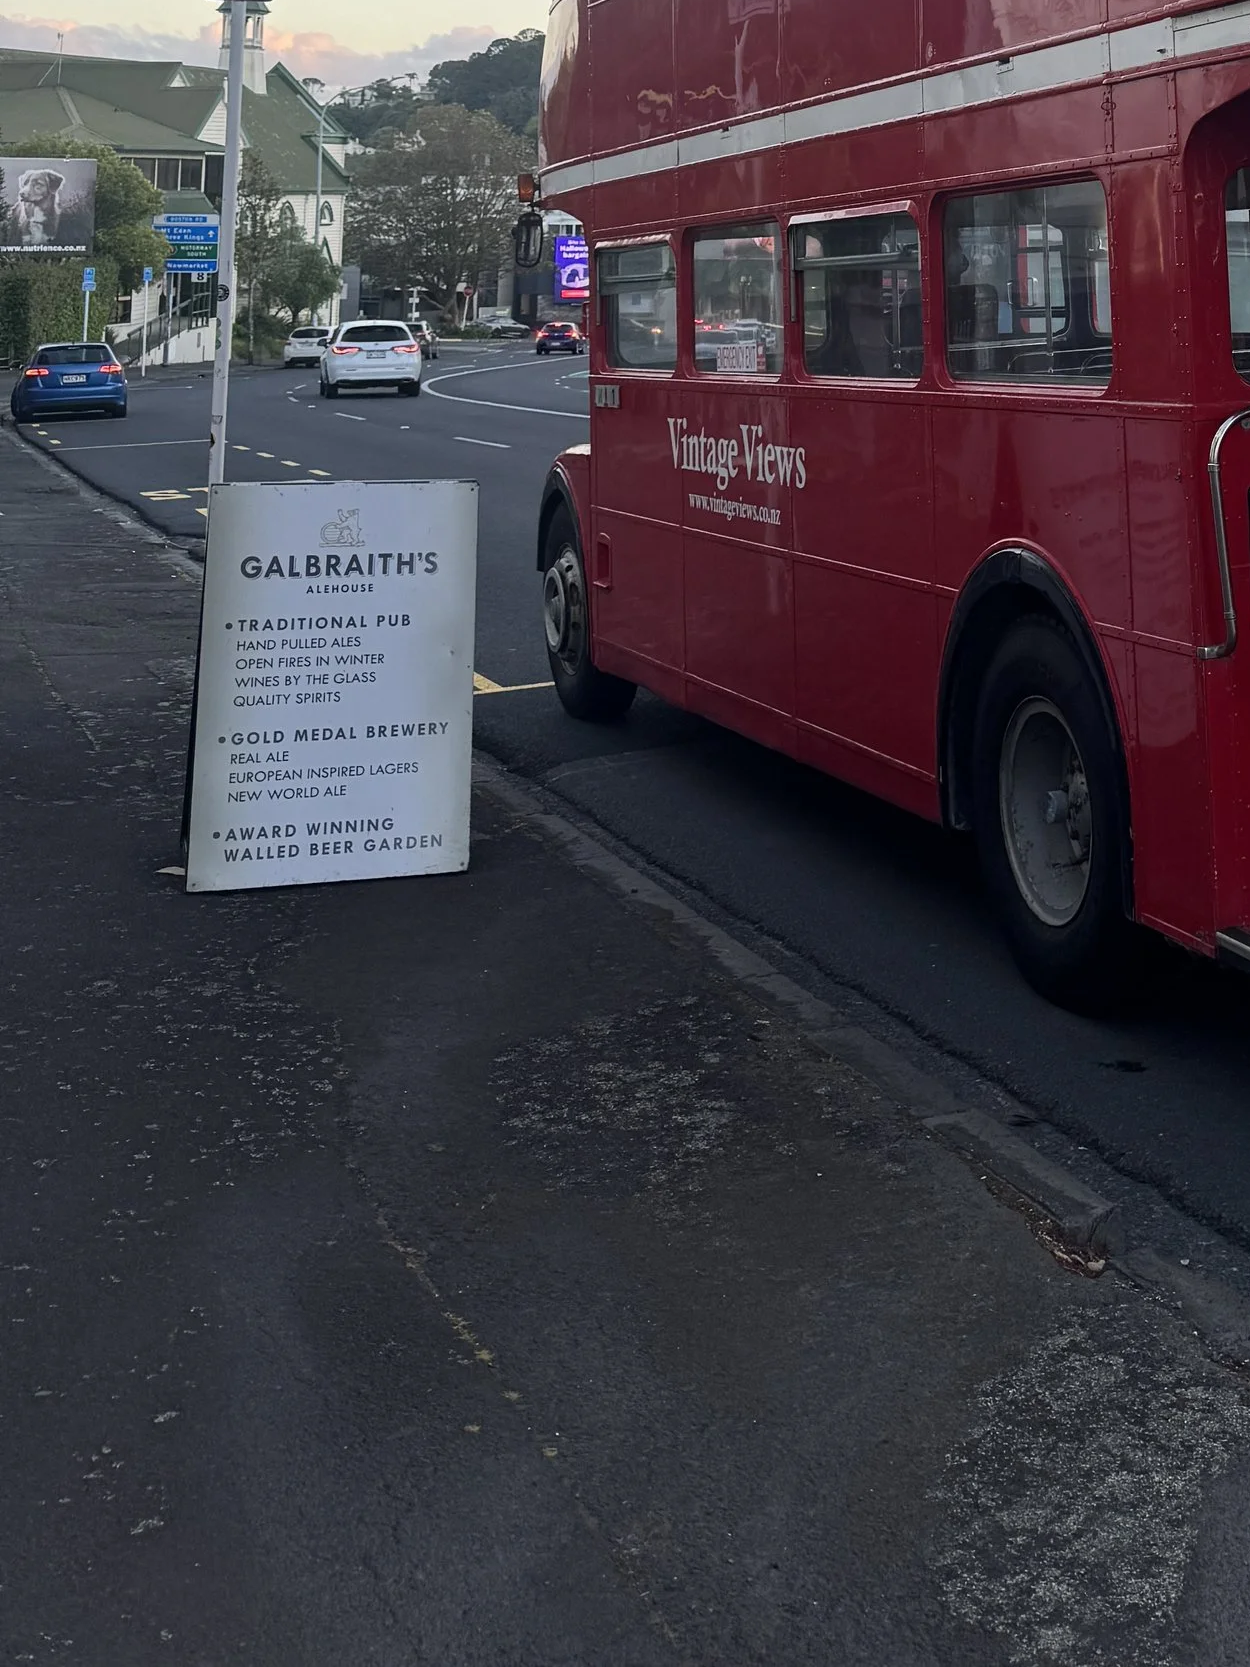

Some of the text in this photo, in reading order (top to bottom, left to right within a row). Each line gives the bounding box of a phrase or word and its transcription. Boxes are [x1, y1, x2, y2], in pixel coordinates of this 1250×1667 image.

[667, 417, 807, 491] Vintage Views
[688, 492, 781, 526] www.vintageviews.co.nz
[240, 551, 439, 580] GALBRAITH'S
[306, 584, 374, 594] ALEHOUSE
[238, 614, 411, 632] TRADITIONAL PUB
[237, 636, 361, 651] HAND PULLED ALES
[236, 654, 385, 670] OPEN FIRES IN WINTER
[235, 671, 376, 688] WINES BY THE GLASS
[233, 691, 341, 708] QUALITY SPIRITS
[231, 722, 449, 746] GOLD MEDAL BREWERY
[230, 751, 289, 764] REAL ALE
[229, 762, 419, 784] EUROPEAN INSPIRED LAGERS
[228, 785, 347, 803] NEW WORLD ALE
[225, 818, 394, 842] AWARD WINNING
[224, 834, 442, 862] WALLED BEER GARDEN
